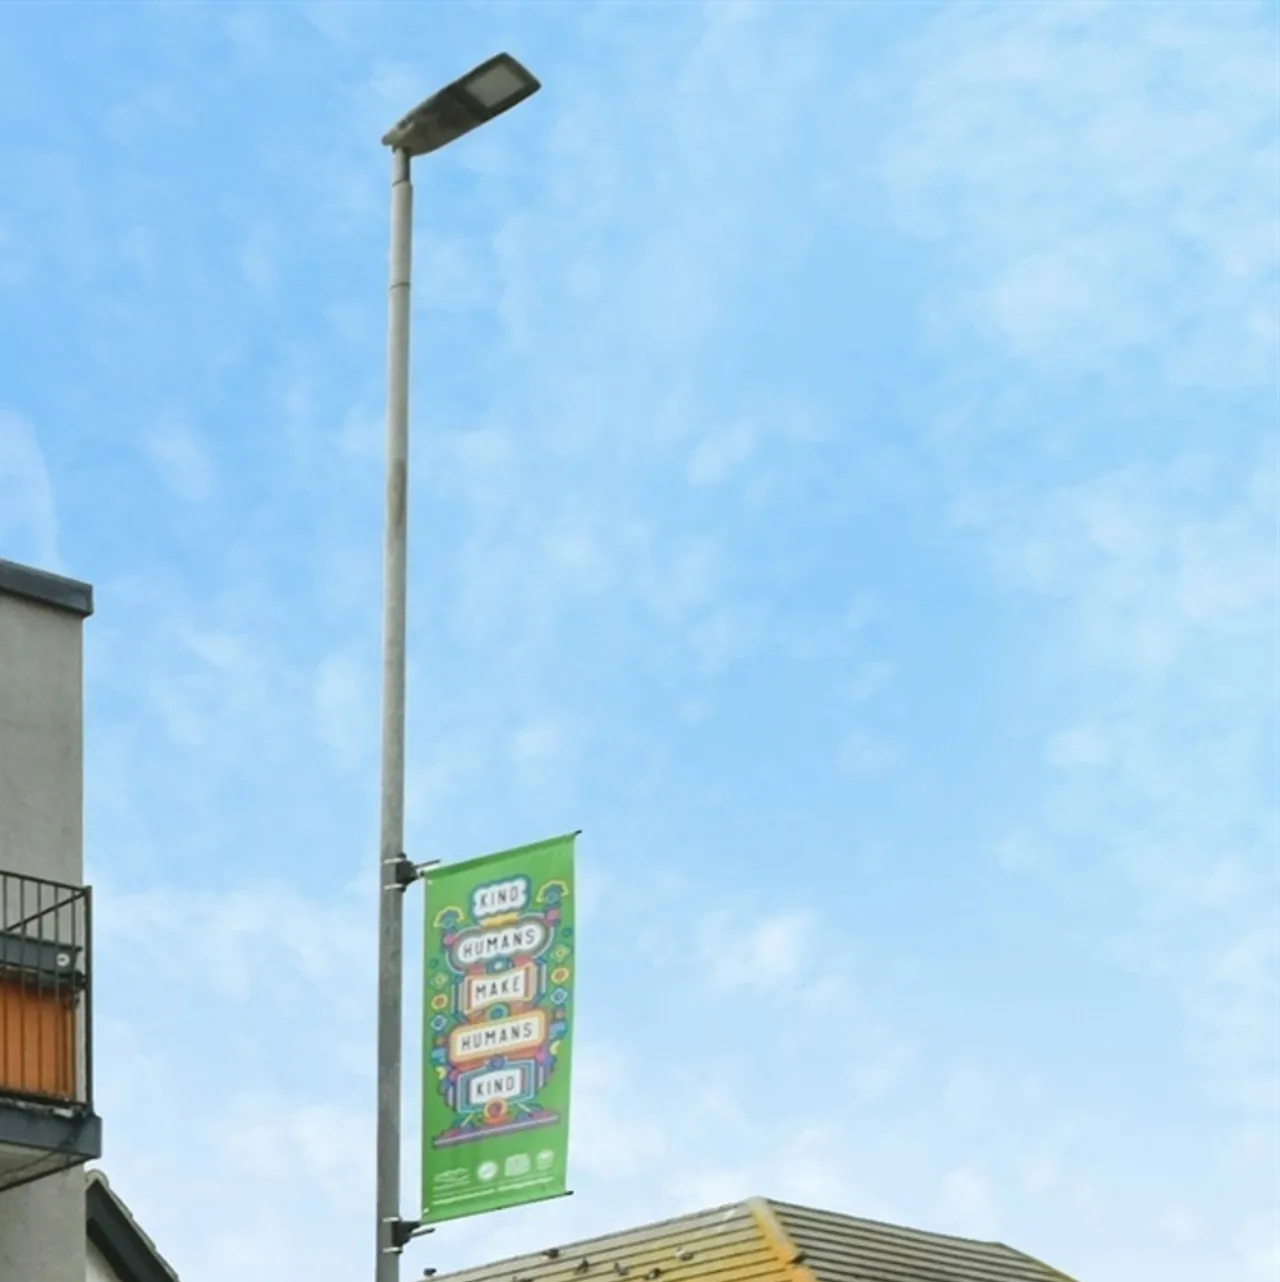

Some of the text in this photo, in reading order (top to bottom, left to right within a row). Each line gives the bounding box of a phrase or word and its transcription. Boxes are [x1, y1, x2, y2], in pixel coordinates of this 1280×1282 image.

[478, 883, 521, 910] KIND
[462, 928, 538, 958] HUMANS
[474, 977, 521, 1001] MAKE
[460, 1022, 535, 1051] HUMANS
[476, 1074, 516, 1097] KIND
